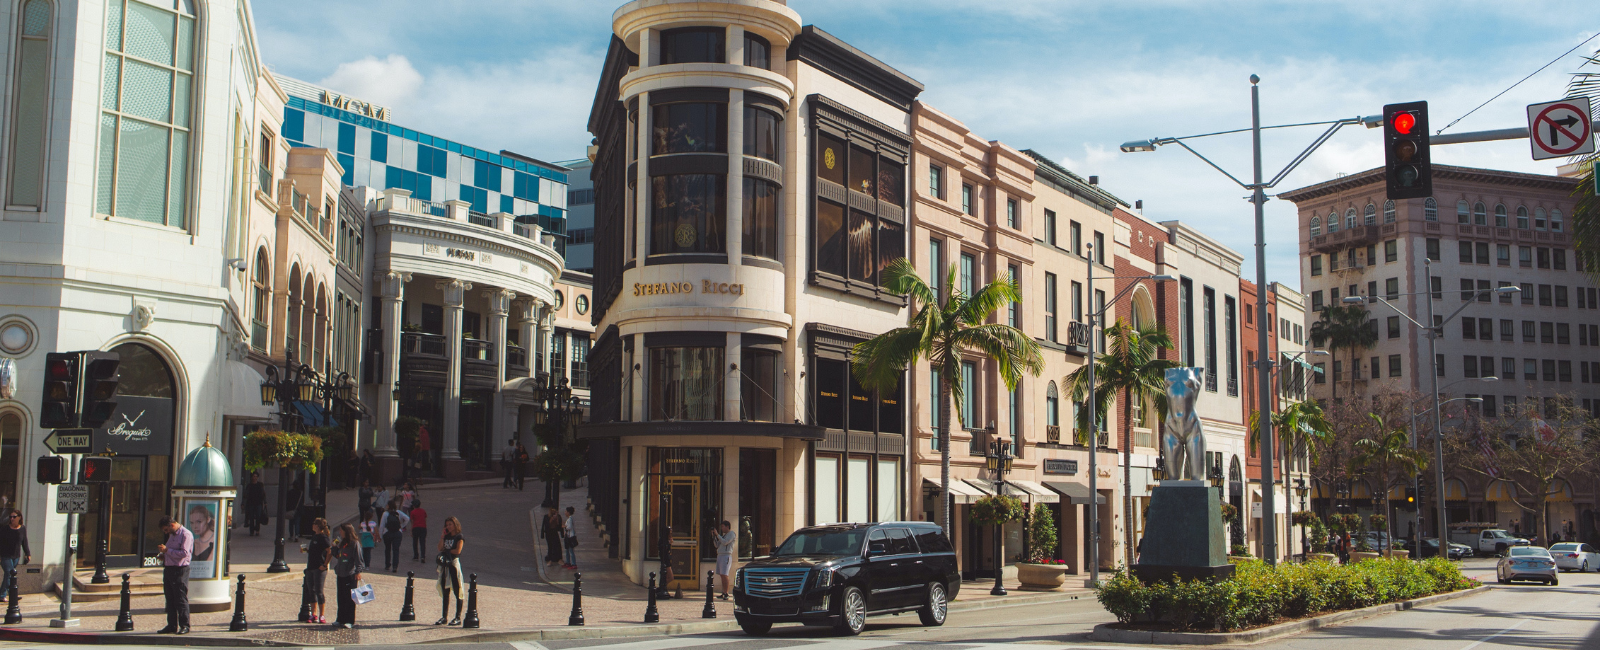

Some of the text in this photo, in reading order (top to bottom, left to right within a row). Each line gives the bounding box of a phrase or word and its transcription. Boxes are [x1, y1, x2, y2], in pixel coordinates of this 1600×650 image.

[323, 90, 387, 121] MGM
[633, 279, 744, 296] STEFANO RICCI
[107, 422, 151, 441] Breguet
[57, 436, 88, 446] ONE WAY
[57, 501, 69, 511] OK
